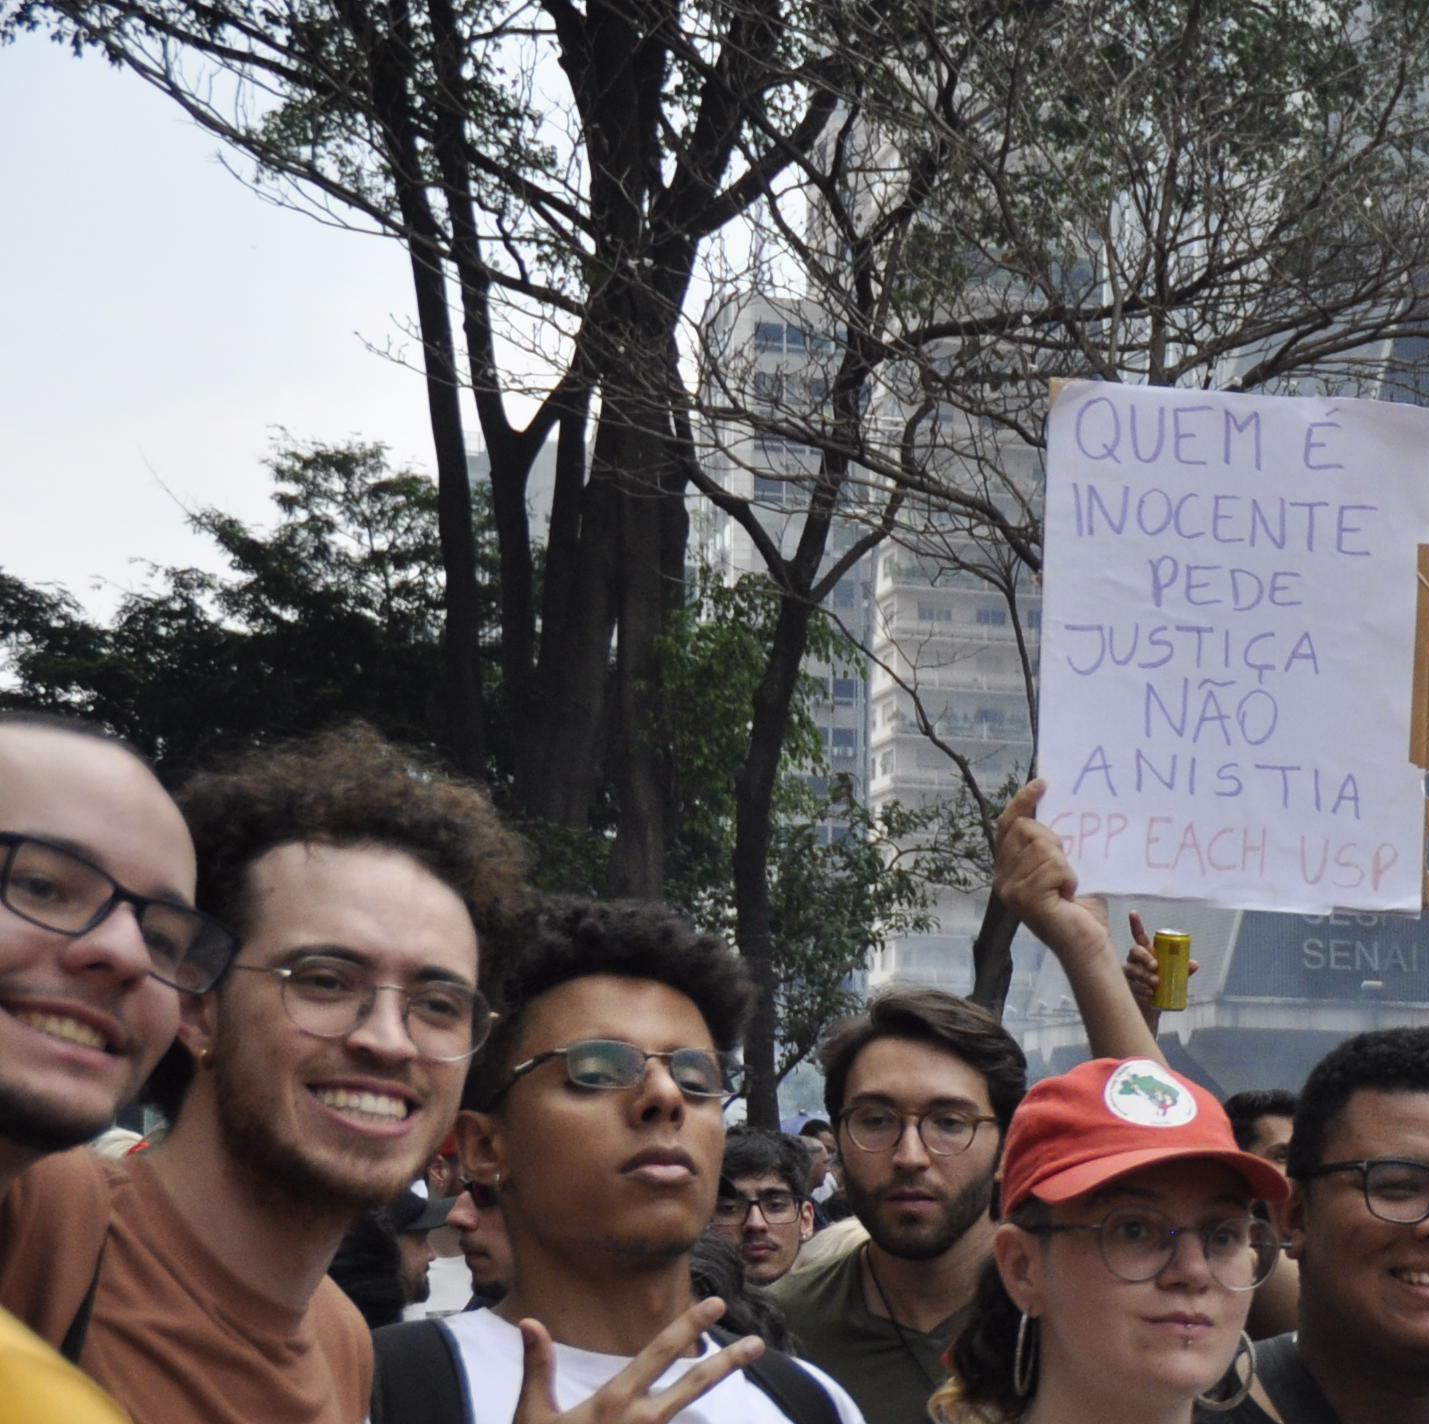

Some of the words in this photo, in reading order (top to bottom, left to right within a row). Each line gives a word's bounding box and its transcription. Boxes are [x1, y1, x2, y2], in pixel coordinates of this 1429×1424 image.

[1075, 396, 1262, 471] QUEM
[1304, 406, 1345, 470] É
[1072, 482, 1379, 556] INOCENTE
[1147, 554, 1303, 612] PEDE
[1064, 624, 1321, 684] JUSTIÇA
[1143, 677, 1279, 746] NÃO
[1071, 744, 1361, 820] ANISTIA
[1143, 815, 1268, 878] EACH
[1299, 835, 1400, 891] USP
[1303, 938, 1419, 972] SENAI
